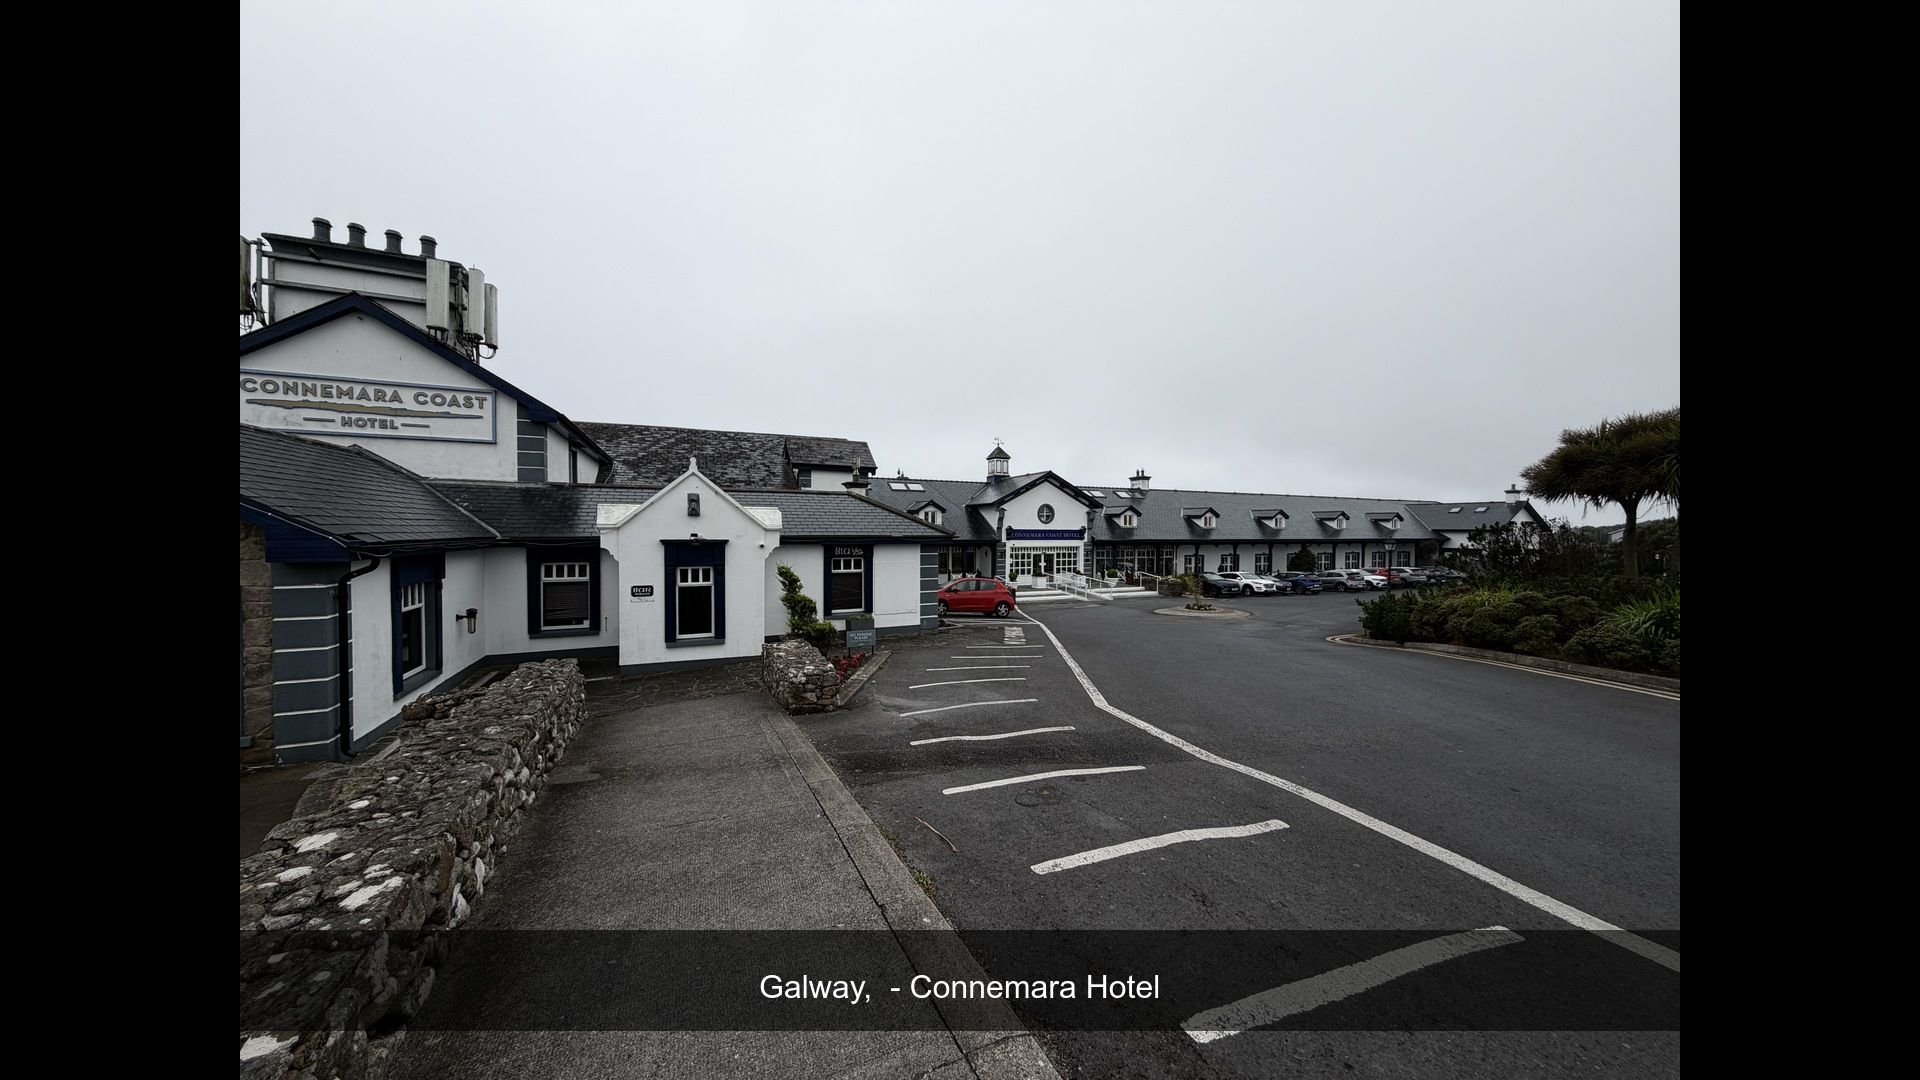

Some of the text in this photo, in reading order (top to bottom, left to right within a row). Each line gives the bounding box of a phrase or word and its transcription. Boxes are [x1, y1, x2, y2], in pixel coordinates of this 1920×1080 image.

[240, 377, 488, 410] CONNEMARA COAST
[340, 415, 399, 430] HOTEL
